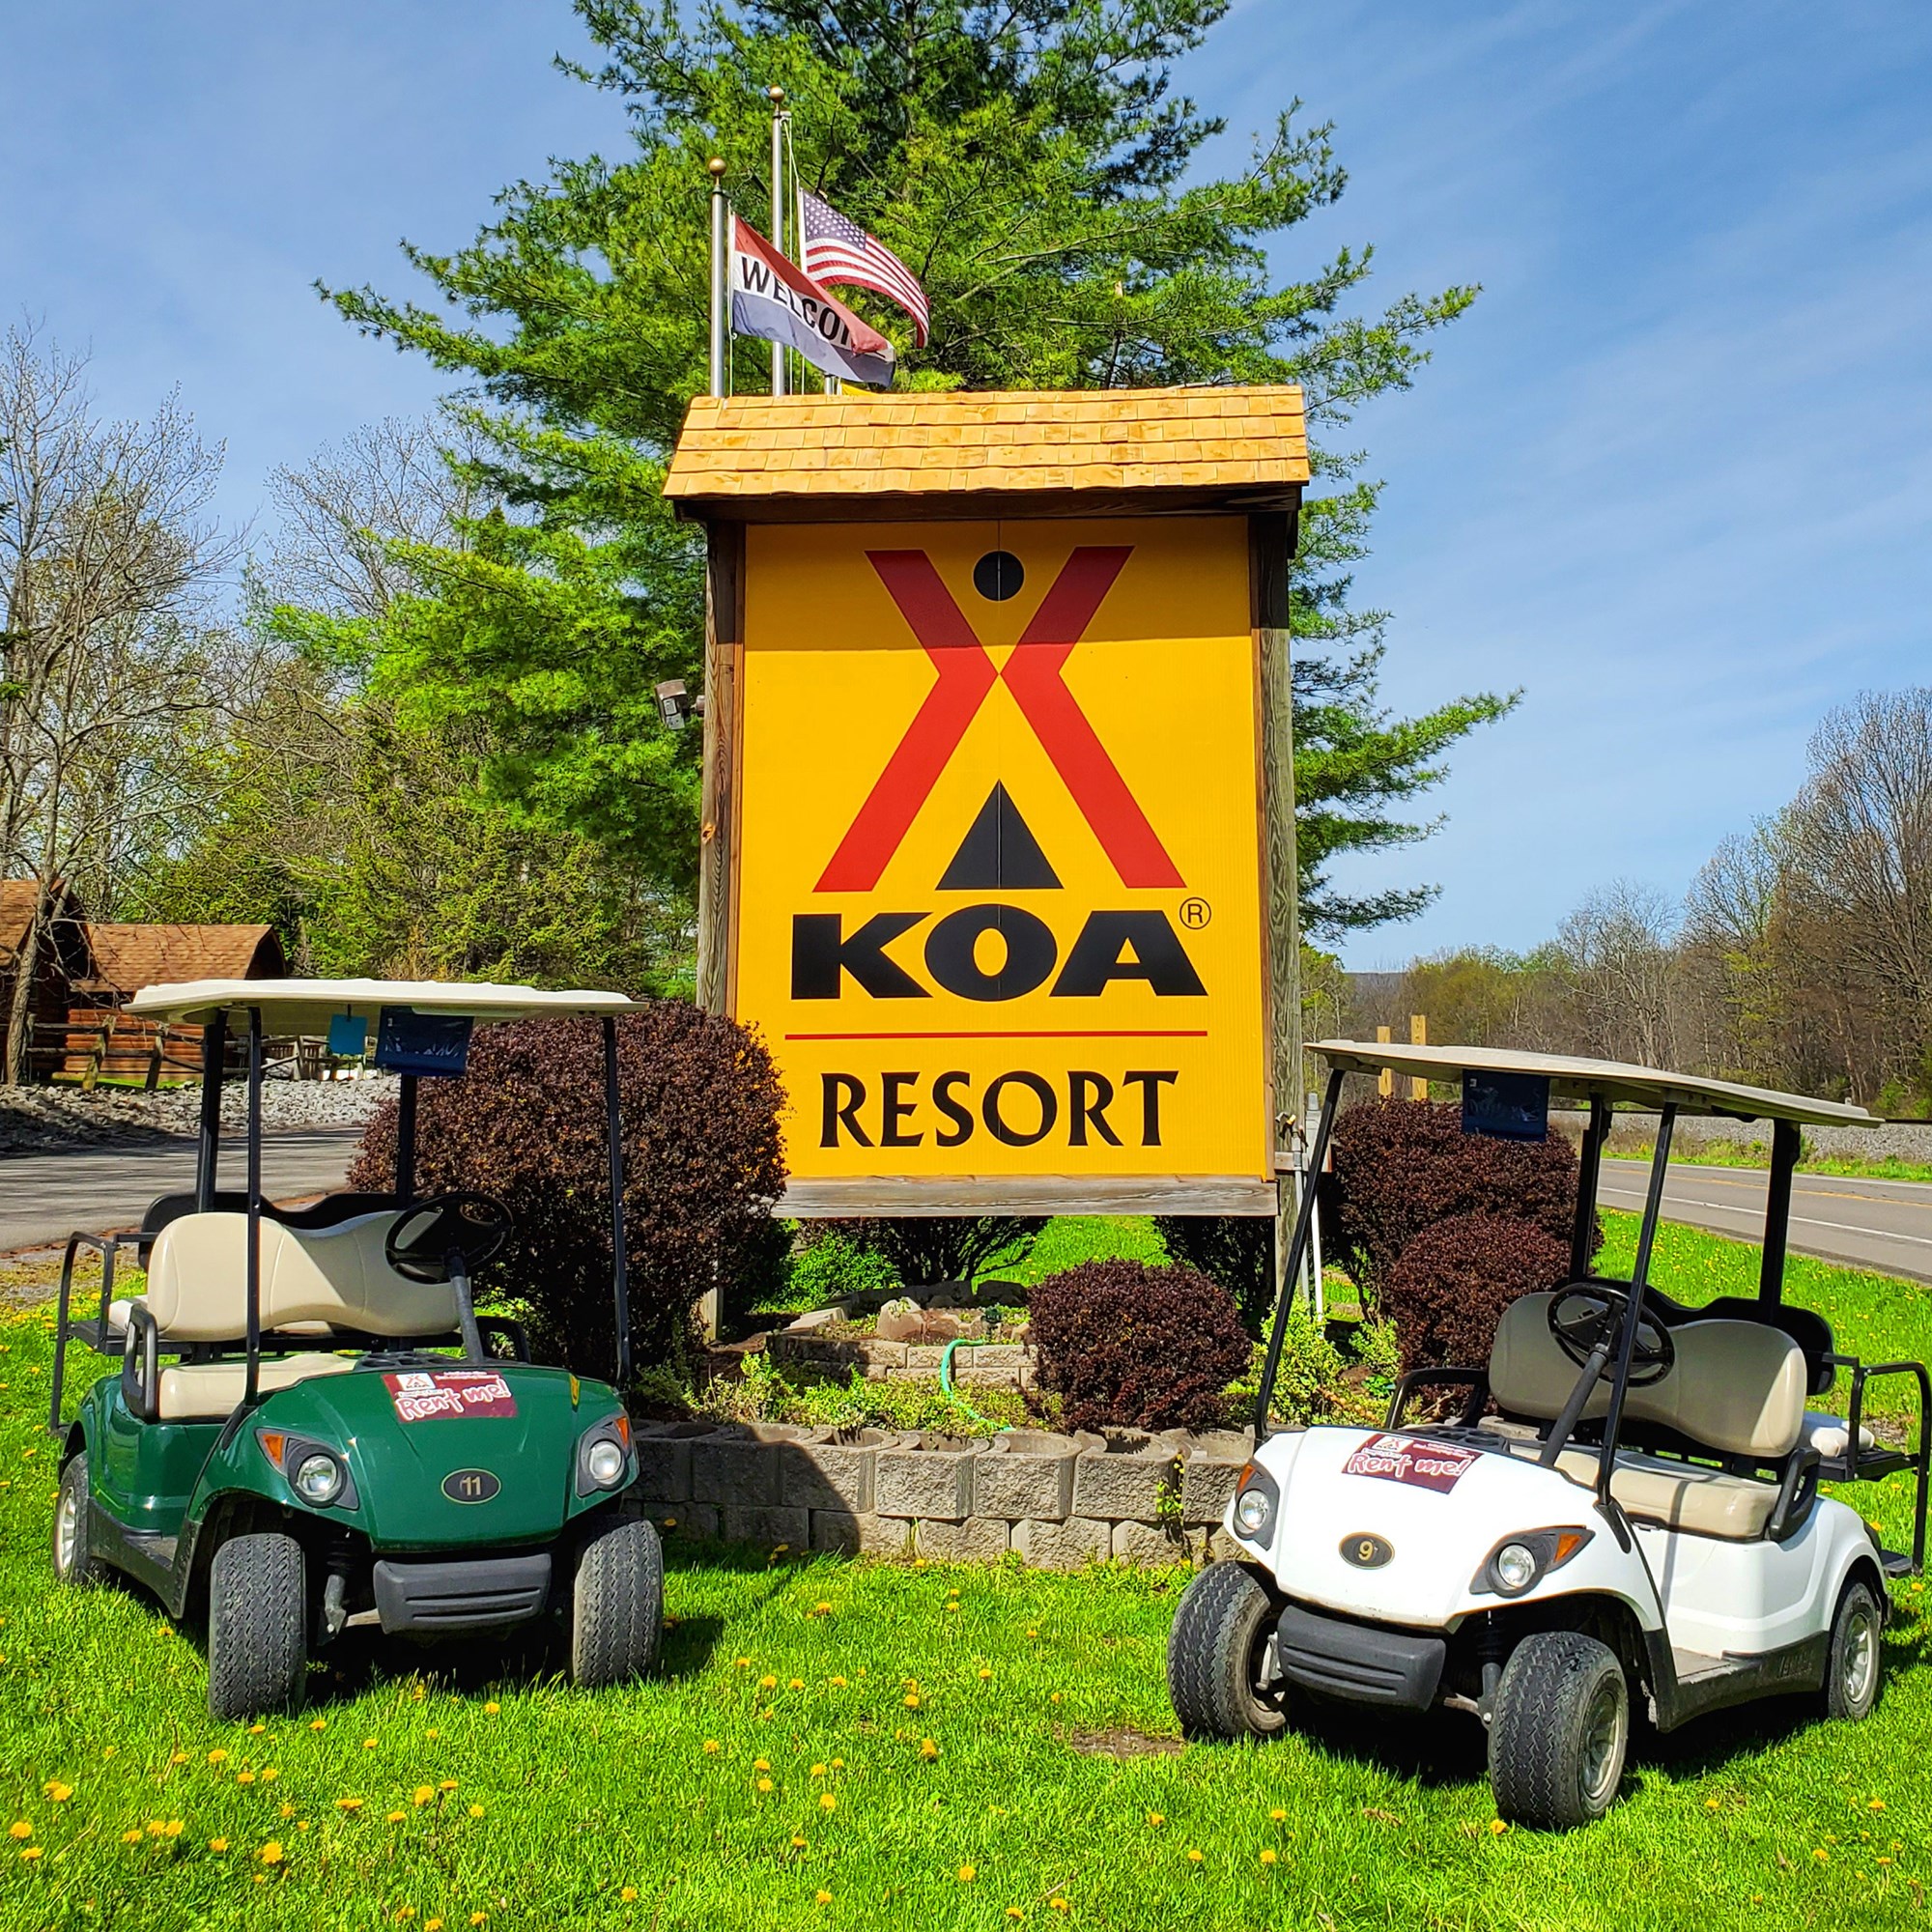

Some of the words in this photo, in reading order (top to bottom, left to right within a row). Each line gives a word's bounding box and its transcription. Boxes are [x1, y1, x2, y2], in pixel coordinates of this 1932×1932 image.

[791, 903, 1208, 1002] KOA
[819, 1070, 1179, 1148] RESORT
[396, 1388, 464, 1420] Rent
[463, 1378, 511, 1403] me!
[1348, 1453, 1412, 1478] Rent
[1414, 1458, 1472, 1477] me!
[462, 1476, 481, 1495] 11
[1358, 1541, 1373, 1560] 9
